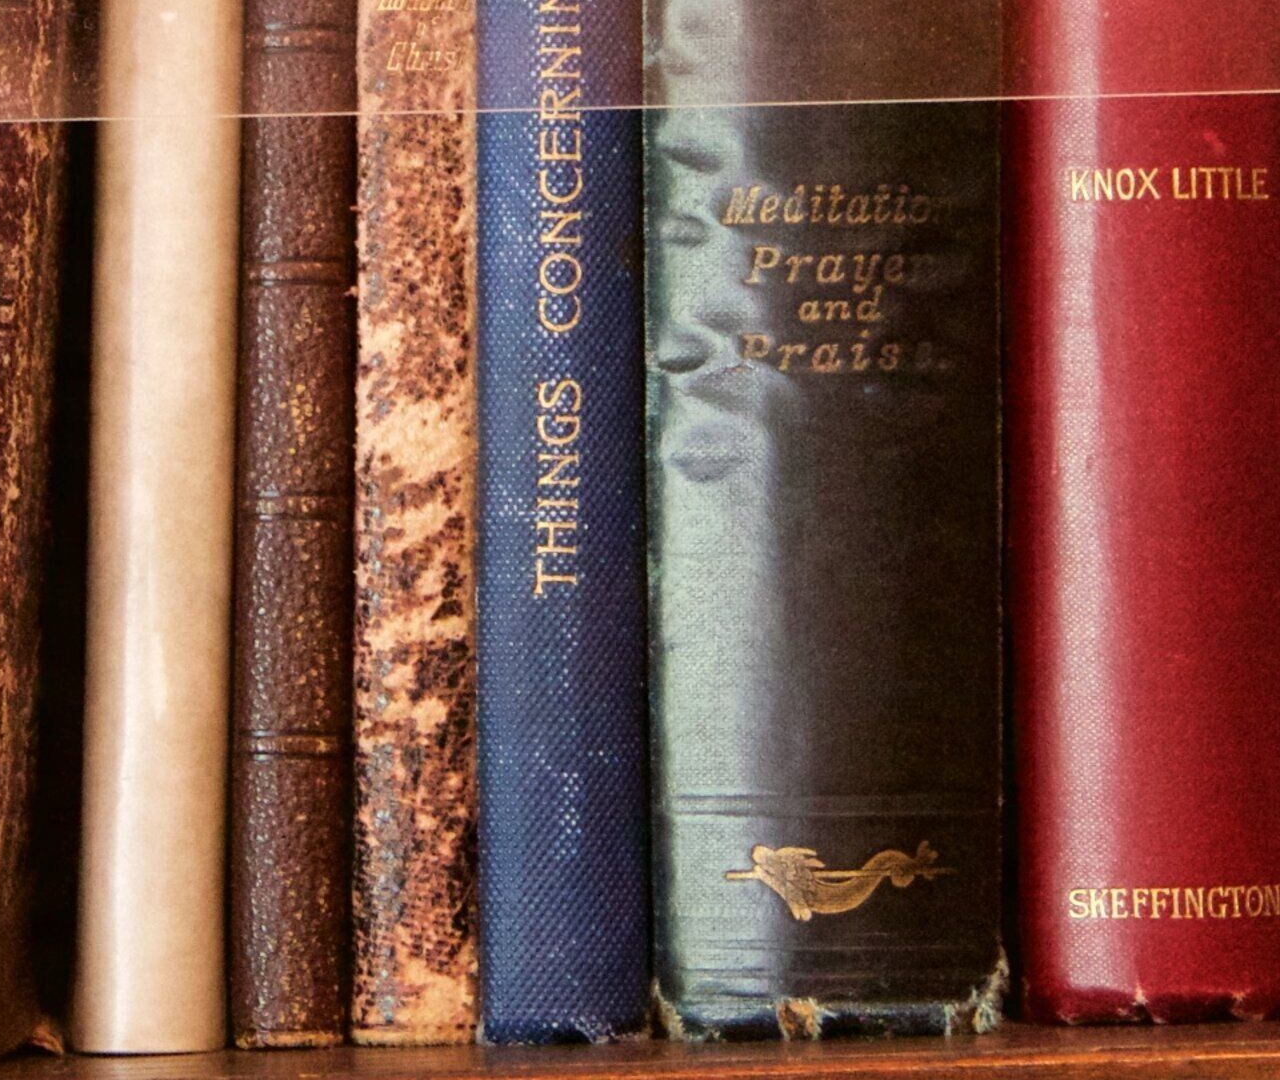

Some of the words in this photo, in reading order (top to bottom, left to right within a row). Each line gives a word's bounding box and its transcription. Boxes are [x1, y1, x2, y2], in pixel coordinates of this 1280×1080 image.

[1071, 167, 1160, 201] KNOX
[1172, 167, 1269, 200] LITTLE
[723, 184, 935, 225] Meditatio
[797, 285, 884, 322] and
[534, 378, 582, 597] THINGS
